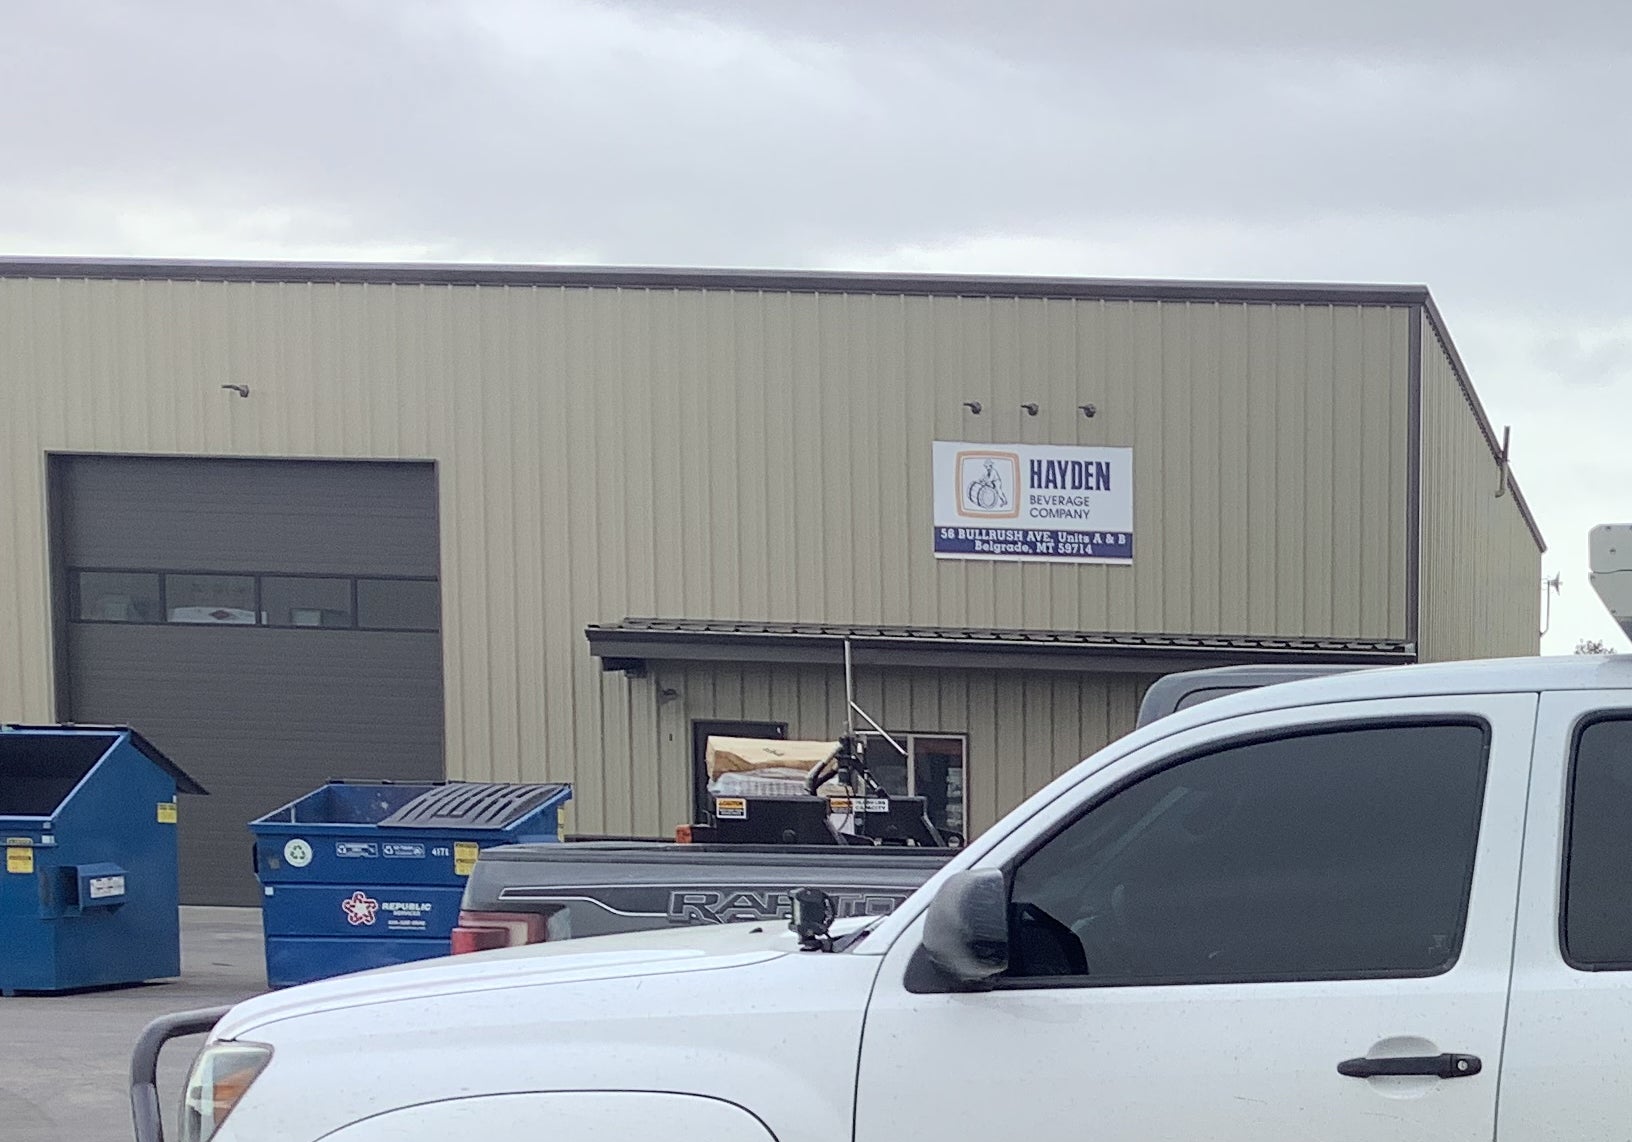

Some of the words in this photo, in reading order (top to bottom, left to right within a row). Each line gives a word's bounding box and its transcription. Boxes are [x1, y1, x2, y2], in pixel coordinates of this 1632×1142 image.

[1029, 459, 1111, 491] HAYDEN
[1029, 494, 1090, 507] BEVERAGE
[1029, 507, 1090, 520] COMPANY
[958, 528, 1024, 542] BULLRUSH
[1058, 532, 1090, 544] Units
[1092, 533, 1103, 544] A
[1105, 534, 1115, 545] &
[1117, 534, 1127, 545] B
[1036, 542, 1055, 554] MT
[1057, 543, 1093, 555] 59714
[381, 902, 432, 911] REPUBLIC
